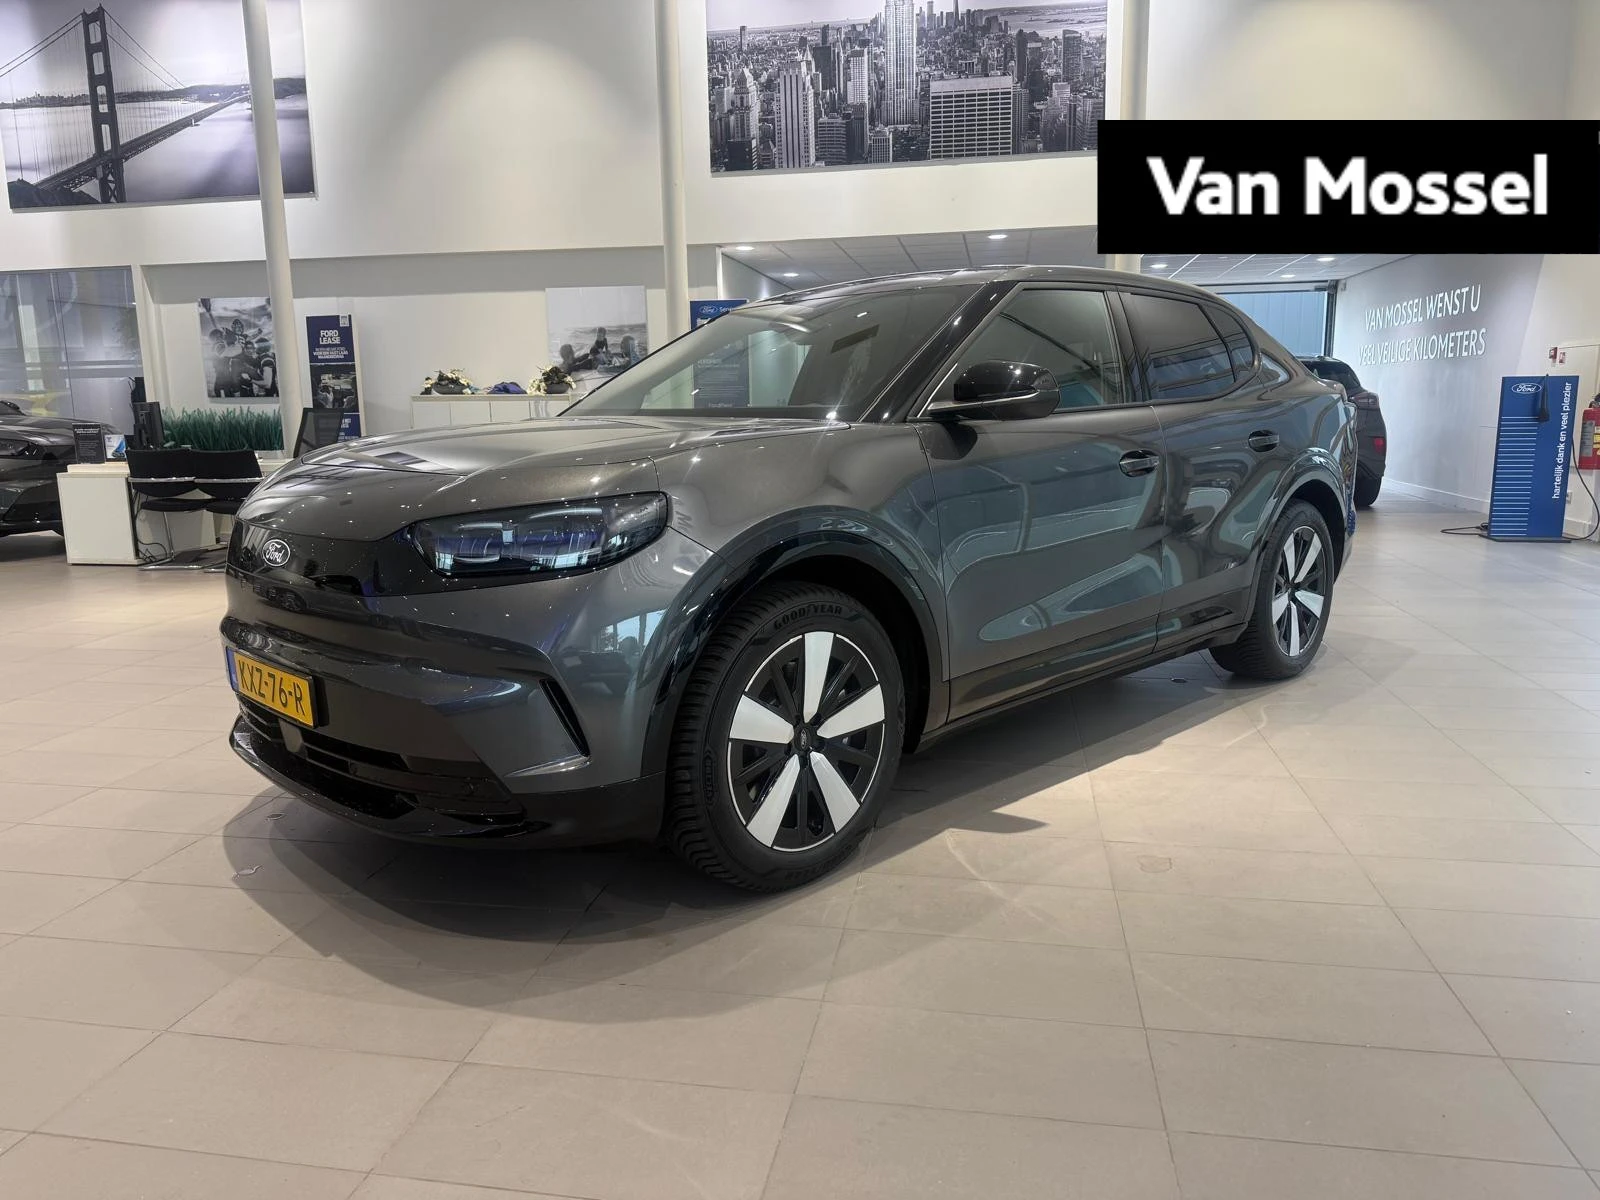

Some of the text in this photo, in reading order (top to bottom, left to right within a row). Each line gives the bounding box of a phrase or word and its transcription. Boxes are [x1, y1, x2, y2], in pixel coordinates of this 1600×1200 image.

[1365, 284, 1481, 333] VAN MOSSEL WENST U
[319, 337, 341, 345] LEASE
[320, 329, 339, 337] FORD
[1359, 327, 1486, 367] VEEL VEILIGE KILOMETERS
[1515, 383, 1538, 393] Ford
[1552, 382, 1572, 499] hartelijk dank en veel plezier
[238, 659, 306, 717] KXZ-76-R
